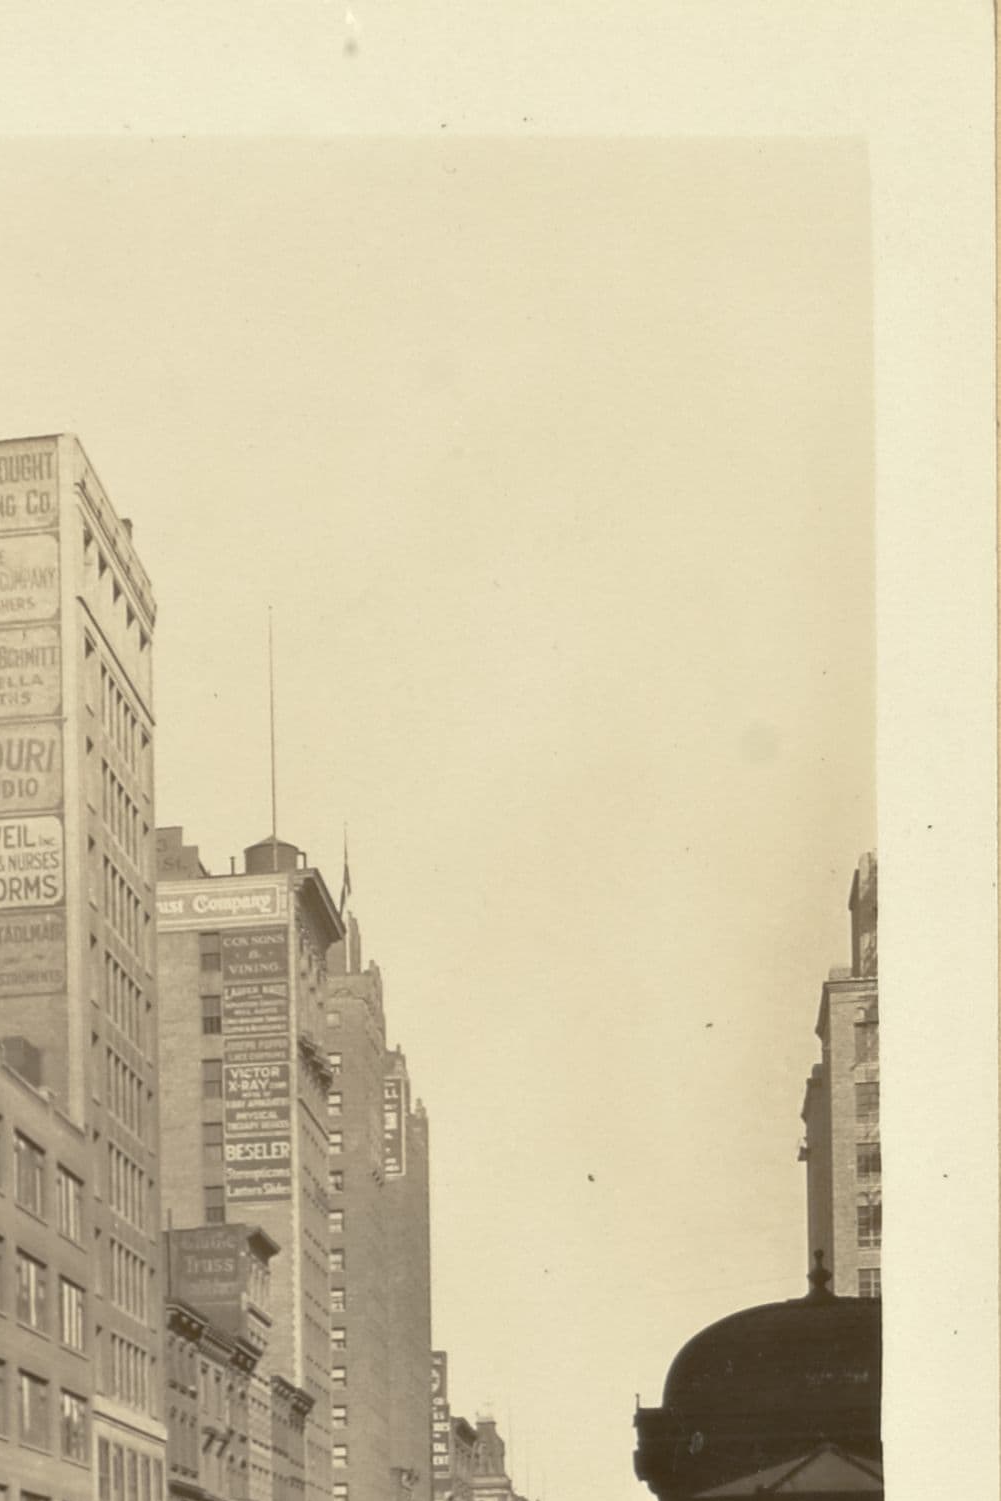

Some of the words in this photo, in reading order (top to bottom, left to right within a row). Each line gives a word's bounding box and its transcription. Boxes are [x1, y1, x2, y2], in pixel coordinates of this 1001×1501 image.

[8, 850, 60, 872] NURSES
[193, 894, 272, 915] Company
[230, 1067, 280, 1080] VICTOR
[227, 1080, 269, 1093] X-RAY
[225, 1142, 291, 1162] BESELER
